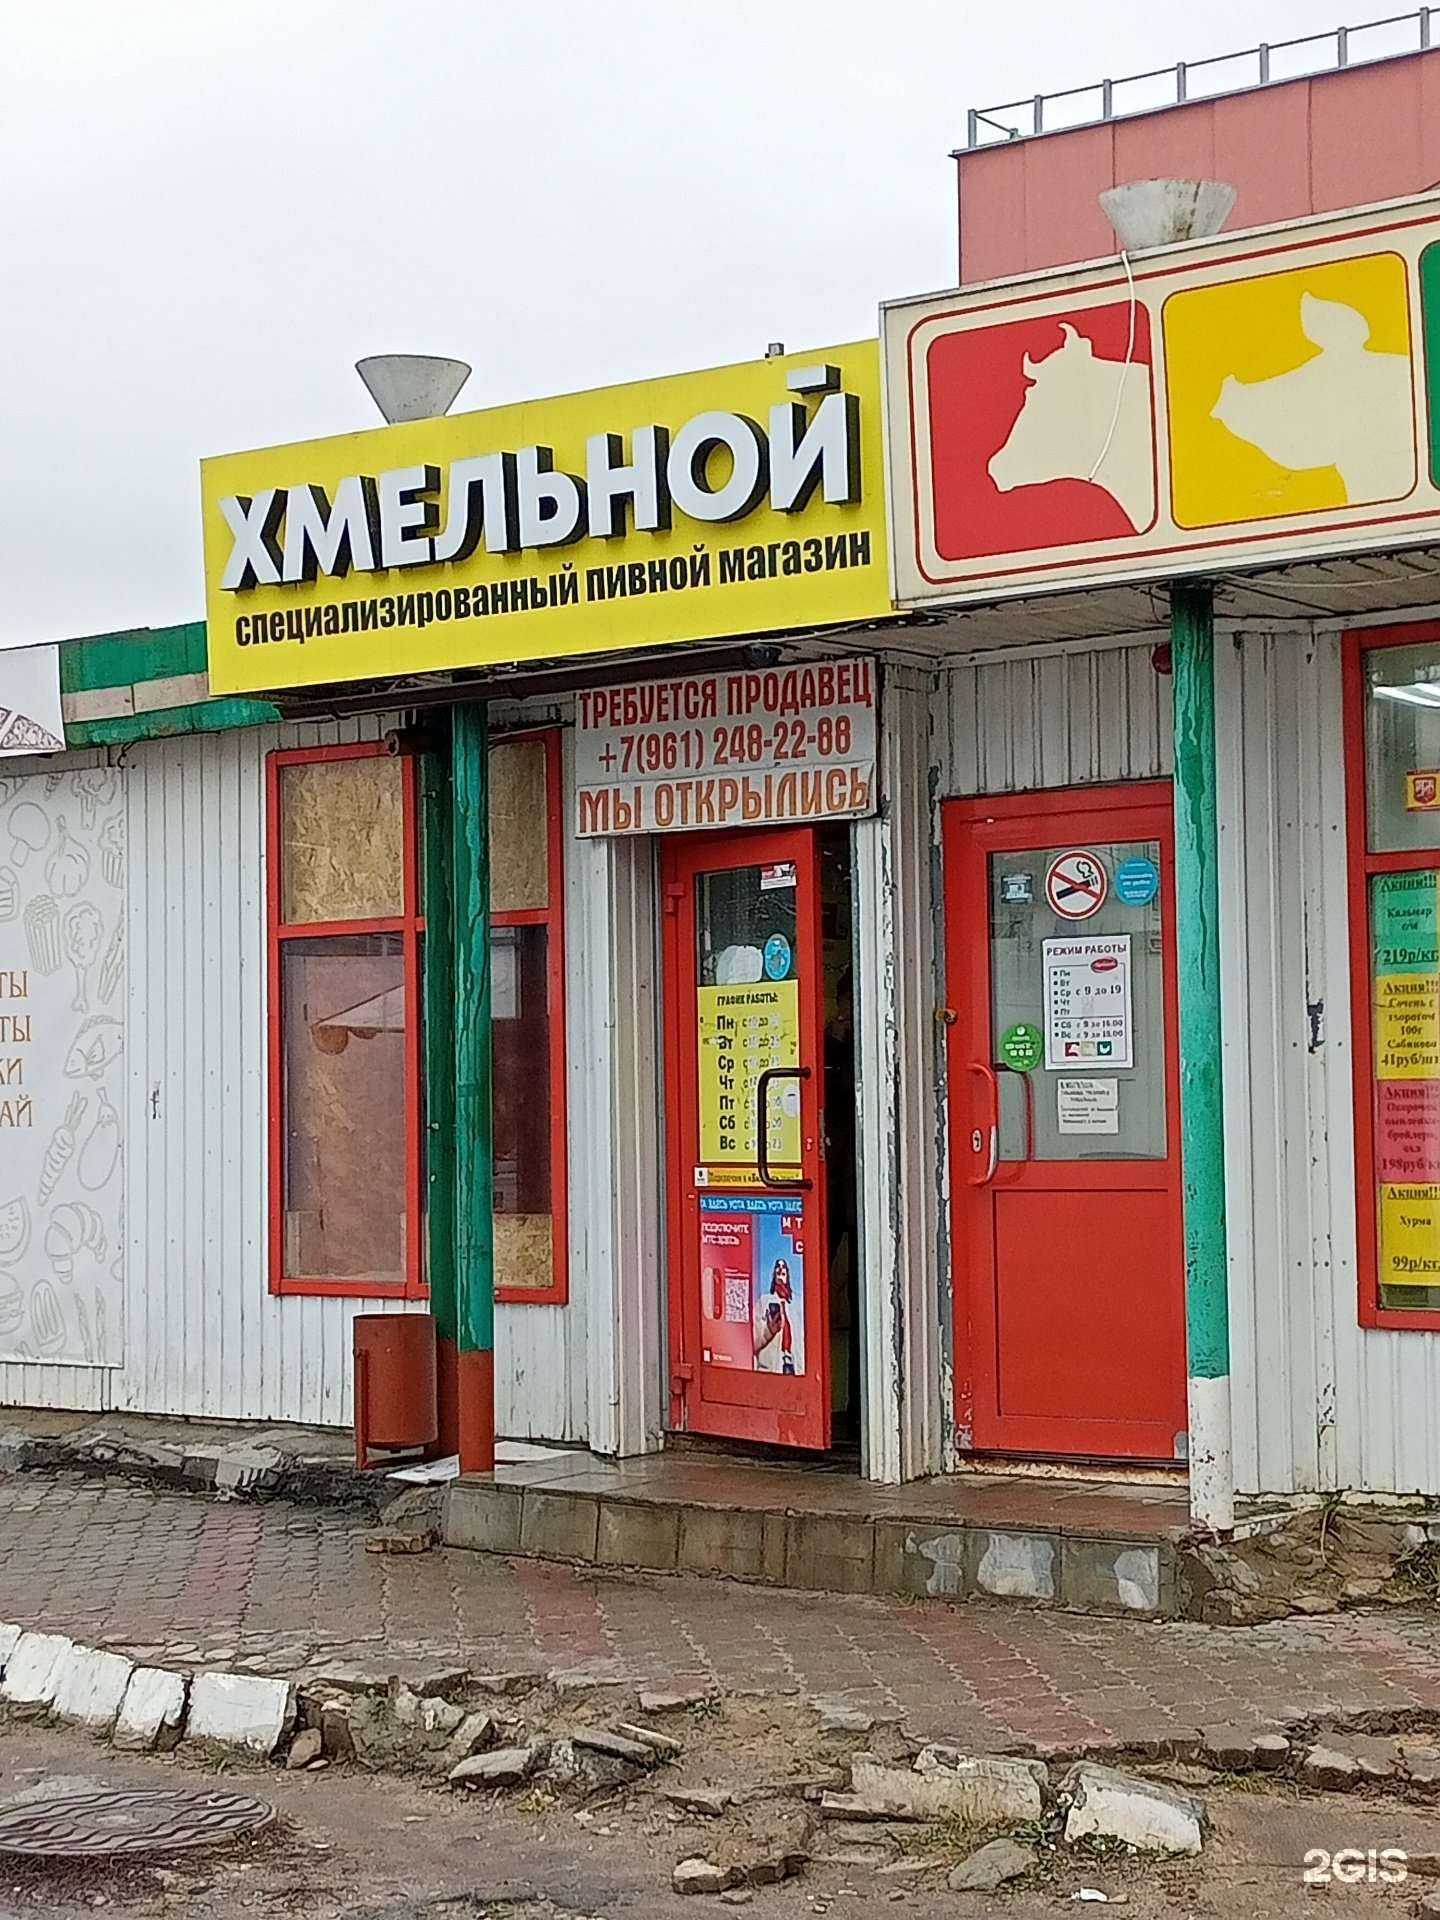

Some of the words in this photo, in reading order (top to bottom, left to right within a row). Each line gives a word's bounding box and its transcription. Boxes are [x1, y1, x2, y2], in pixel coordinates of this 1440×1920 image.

[220, 364, 859, 590] ХМЕЛЬНОЙ
[236, 562, 579, 647] специализированный
[586, 544, 710, 600] пивной
[719, 531, 871, 583] магазин
[579, 678, 717, 730] ТРЕБУЕТСЯ
[727, 662, 873, 717] ПРОДАВЕЦ
[598, 728, 704, 774] +7(961)
[713, 715, 851, 765] 248-22-88
[579, 786, 642, 833] МЫ
[654, 767, 870, 827] ОТКРЫЛИСЬ
[1047, 945, 1083, 956] РЕЖИМ
[1085, 943, 1127, 955] РАБОТЫ
[1110, 984, 1121, 994] 19
[717, 1015, 734, 1030] Пн
[718, 1055, 735, 1073] Ср
[719, 1075, 735, 1089] Чт
[719, 1095, 735, 1110] Пт
[719, 1115, 736, 1130] Сб
[720, 1135, 736, 1150] Вс
